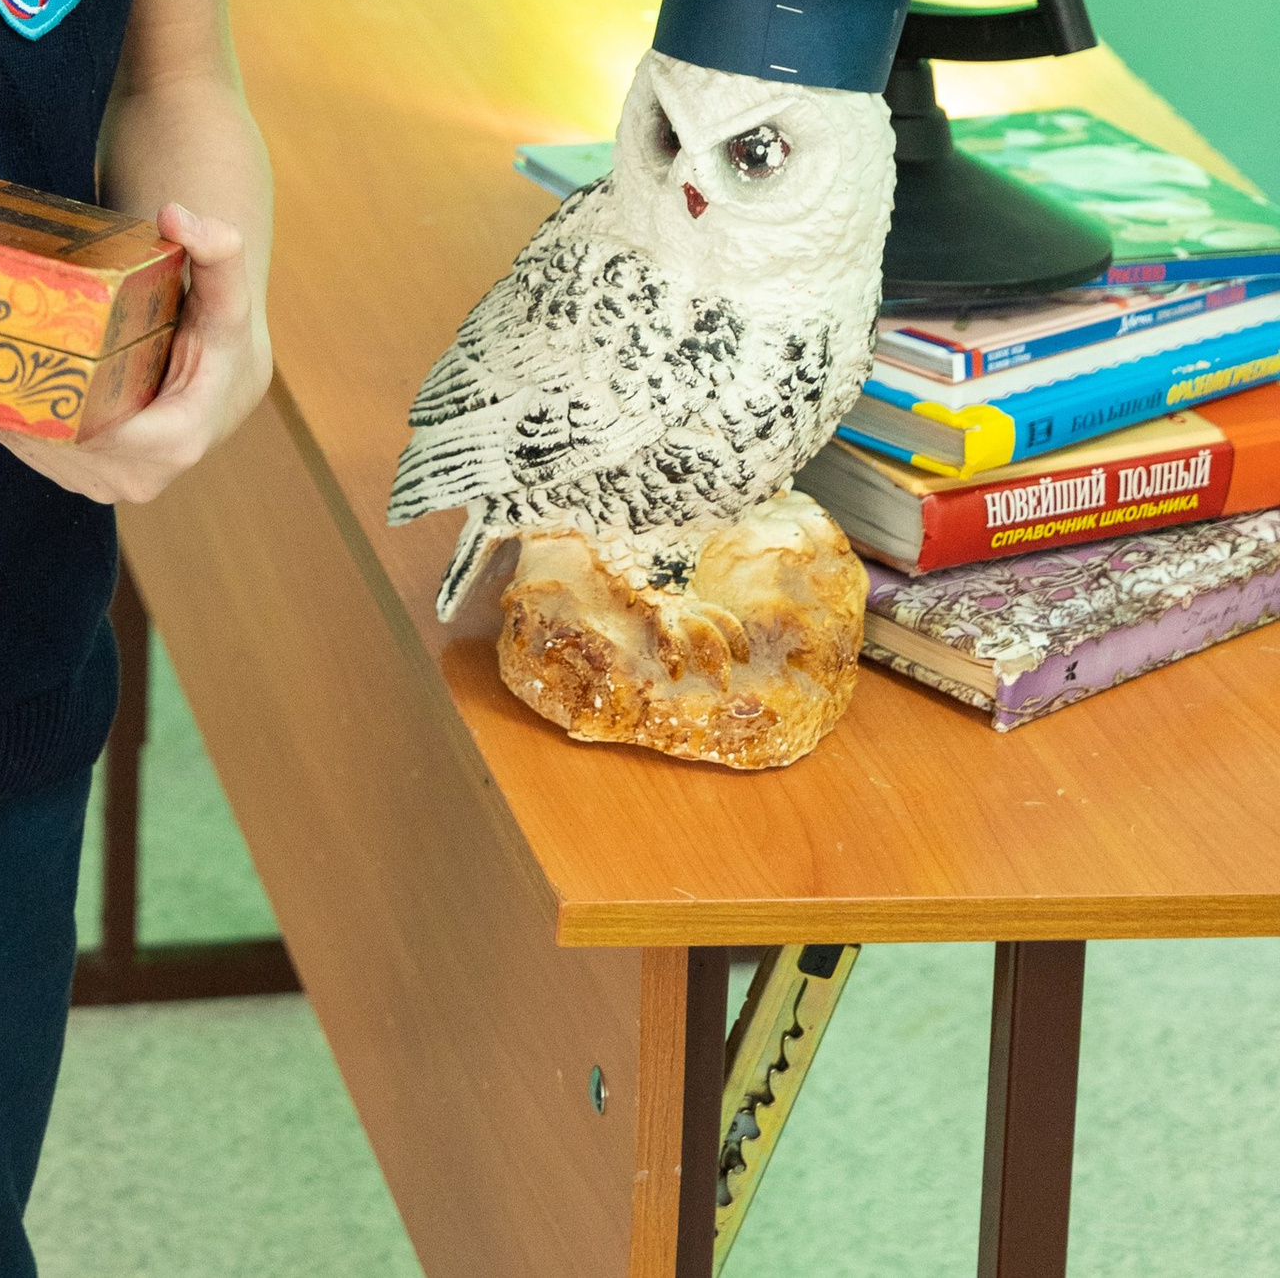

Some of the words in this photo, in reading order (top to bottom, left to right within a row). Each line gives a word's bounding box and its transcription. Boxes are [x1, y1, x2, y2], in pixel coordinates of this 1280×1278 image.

[1071, 388, 1163, 434] БОЛЬШОЙ
[984, 467, 1107, 529] НОВЕЙШИЙ
[1117, 449, 1213, 504] ПОЛНЫЙ
[990, 513, 1098, 549] СПРАВОЧНИК
[1099, 493, 1200, 528] ШКОЛЬНИКА
